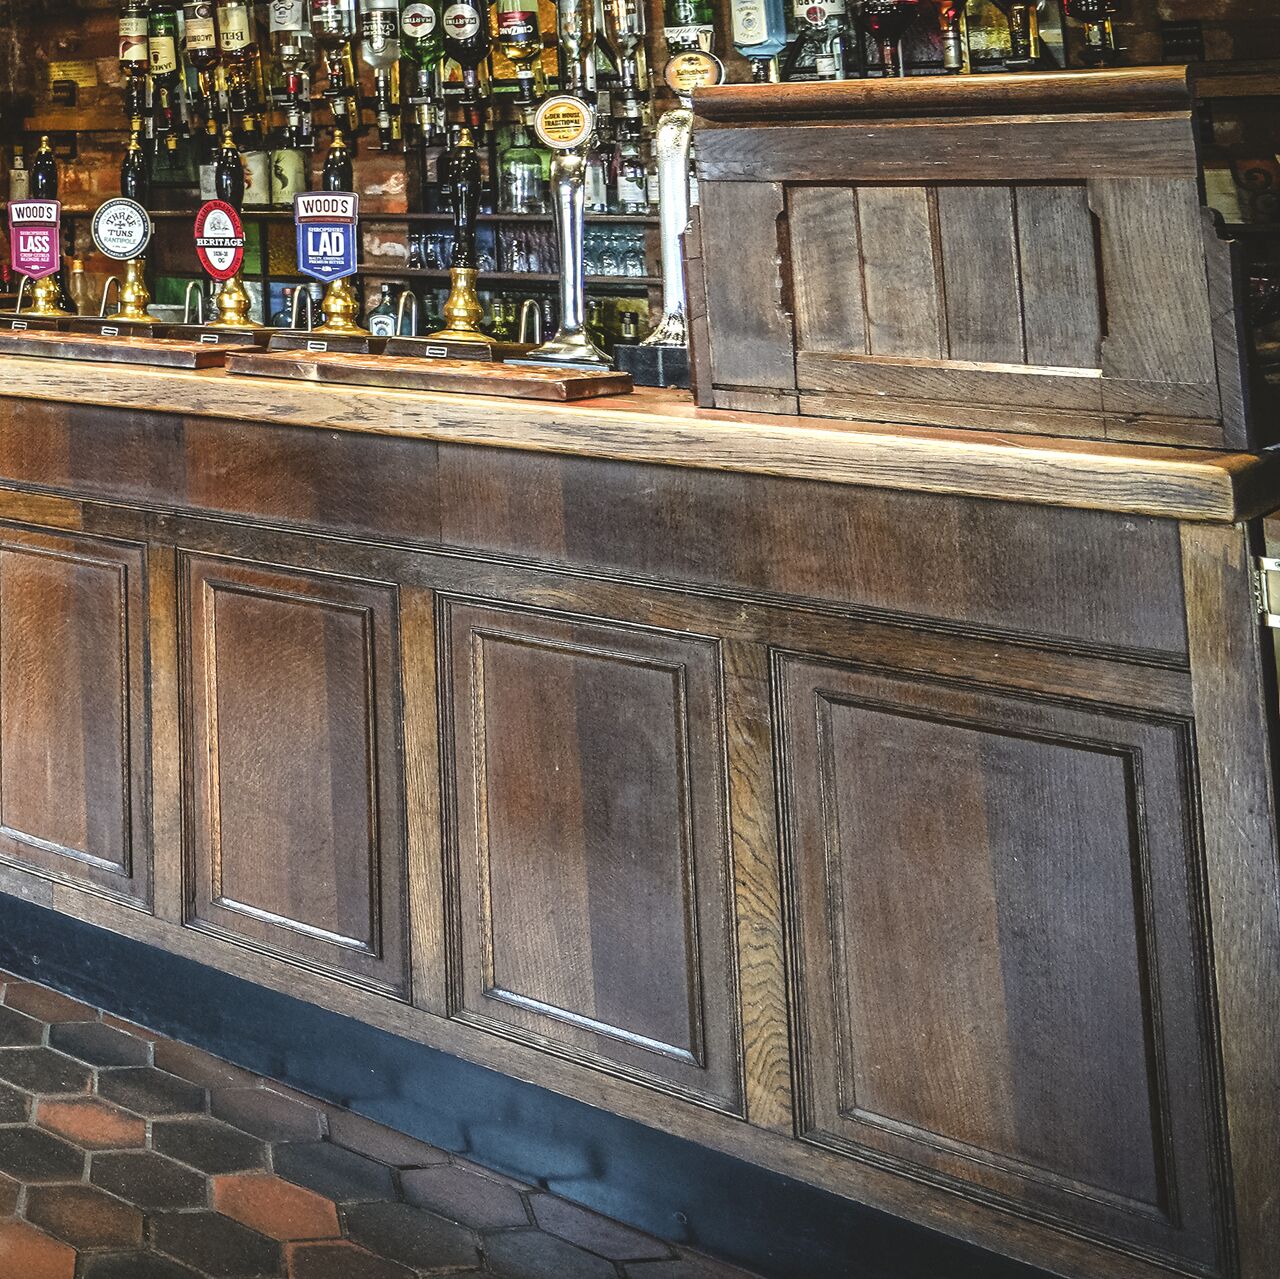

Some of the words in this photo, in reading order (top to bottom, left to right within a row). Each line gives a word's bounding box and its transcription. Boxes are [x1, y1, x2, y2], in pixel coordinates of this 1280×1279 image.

[15, 206, 52, 219] WOOD'S
[303, 199, 349, 213] WOOD'S
[106, 211, 137, 227] THREE
[107, 229, 134, 238] TUNS
[19, 236, 50, 253] LASS
[197, 238, 244, 247] HERITAGE
[308, 232, 345, 256] LAD
